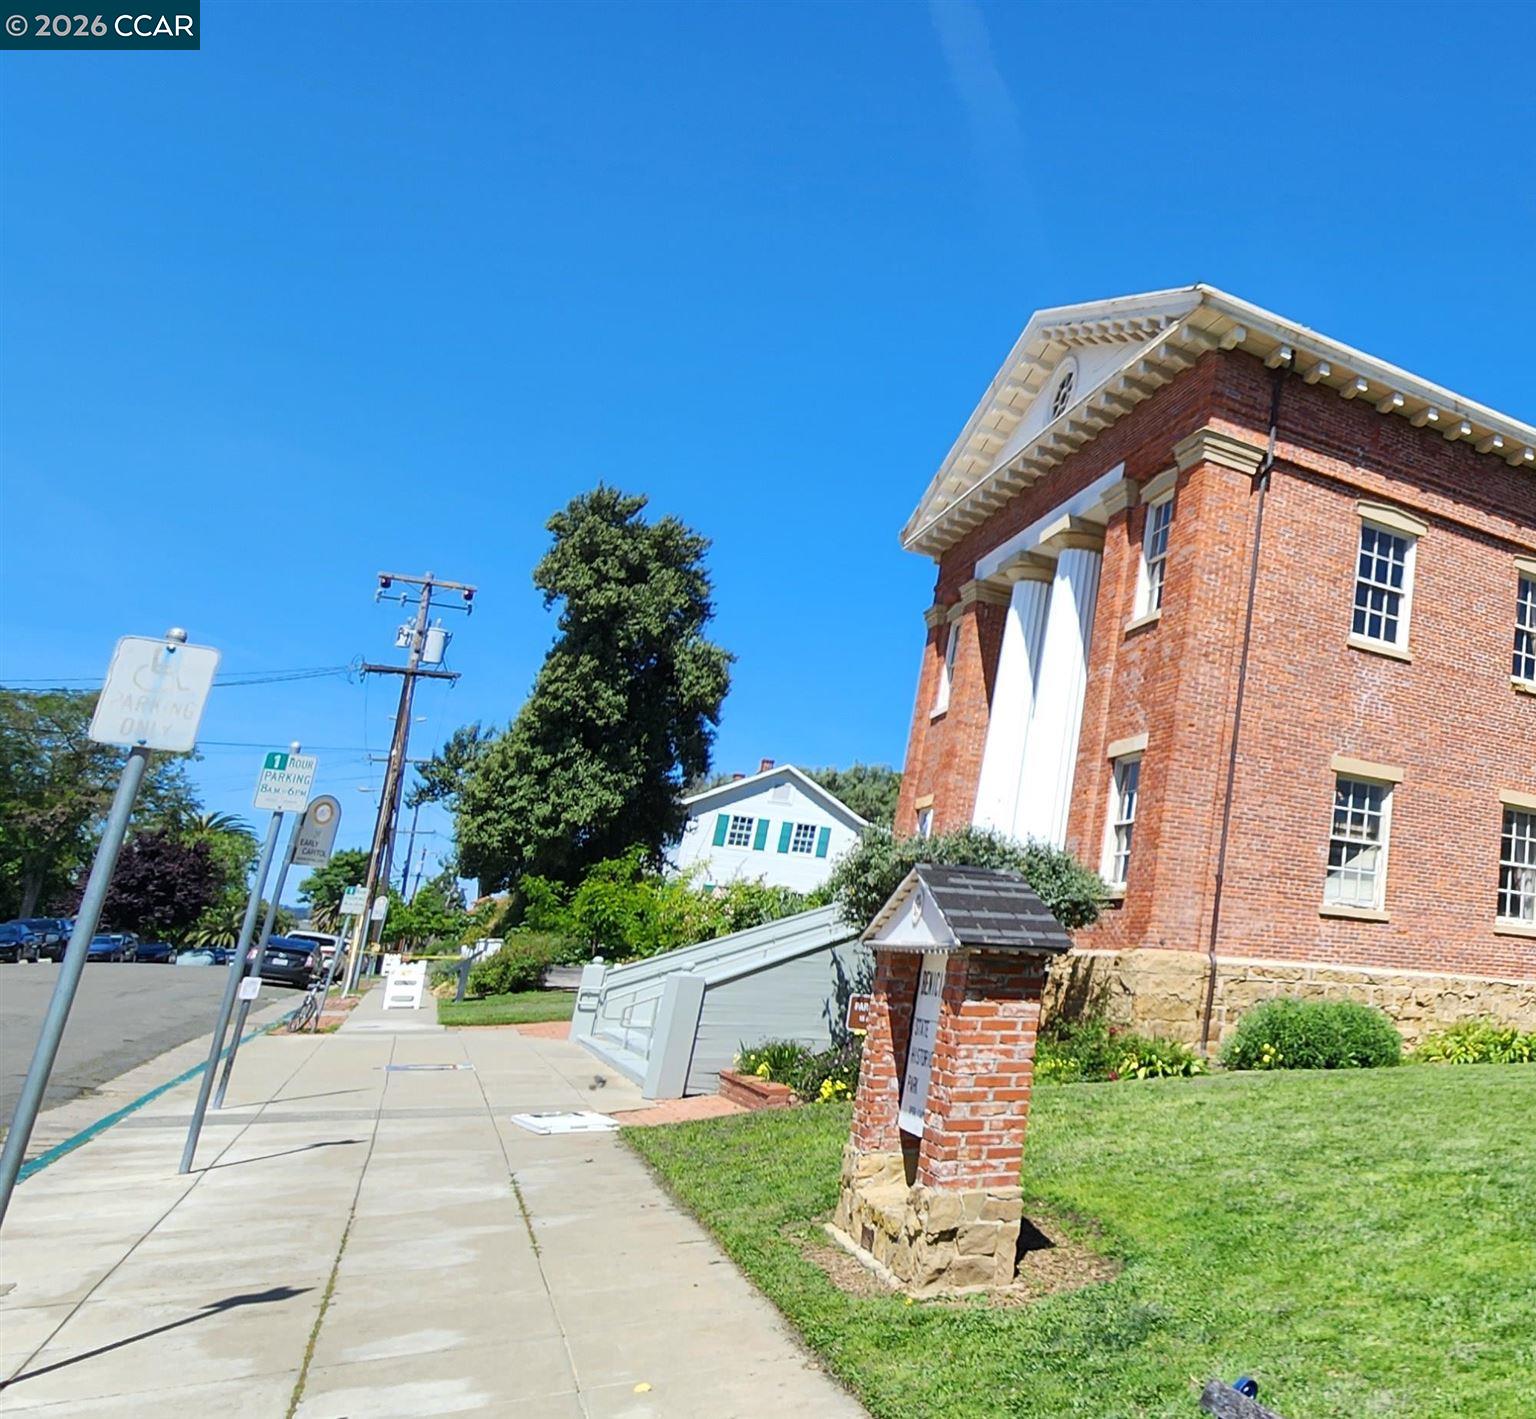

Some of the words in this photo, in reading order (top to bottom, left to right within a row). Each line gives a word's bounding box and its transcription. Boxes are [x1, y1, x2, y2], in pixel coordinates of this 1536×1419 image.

[111, 691, 197, 720] PARKNG
[273, 754, 282, 769] 1
[289, 757, 314, 769] HOUR
[264, 770, 312, 785] PARKING
